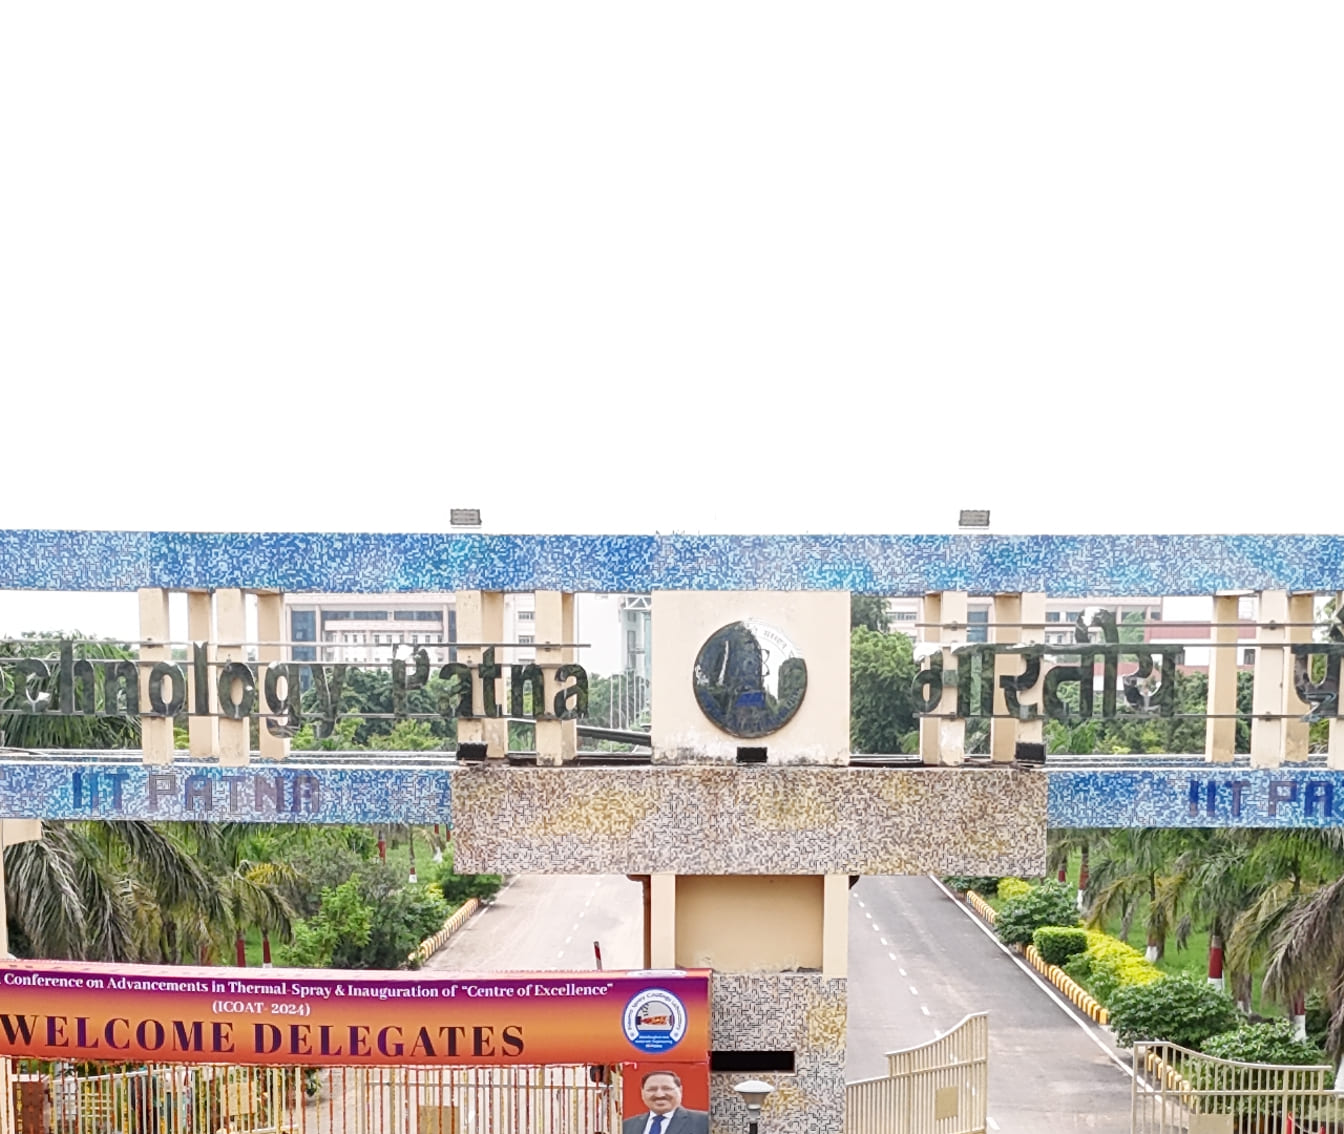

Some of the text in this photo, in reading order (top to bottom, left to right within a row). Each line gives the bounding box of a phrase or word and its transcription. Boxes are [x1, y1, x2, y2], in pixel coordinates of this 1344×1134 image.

[392, 644, 589, 720] Patna
[912, 607, 1186, 720] भारतीय
[72, 772, 320, 815] IIT PATNA
[1188, 779, 1252, 818] IIT
[4, 973, 84, 989] Conference
[86, 978, 104, 989] on
[107, 977, 209, 993] Advancements
[212, 980, 224, 993] in
[335, 984, 345, 996] &
[348, 983, 439, 1001] Inauguration
[442, 984, 458, 997] of
[516, 984, 534, 997] of
[271, 1003, 311, 1017] 2024)
[252, 1023, 525, 1057] DELEGATES
